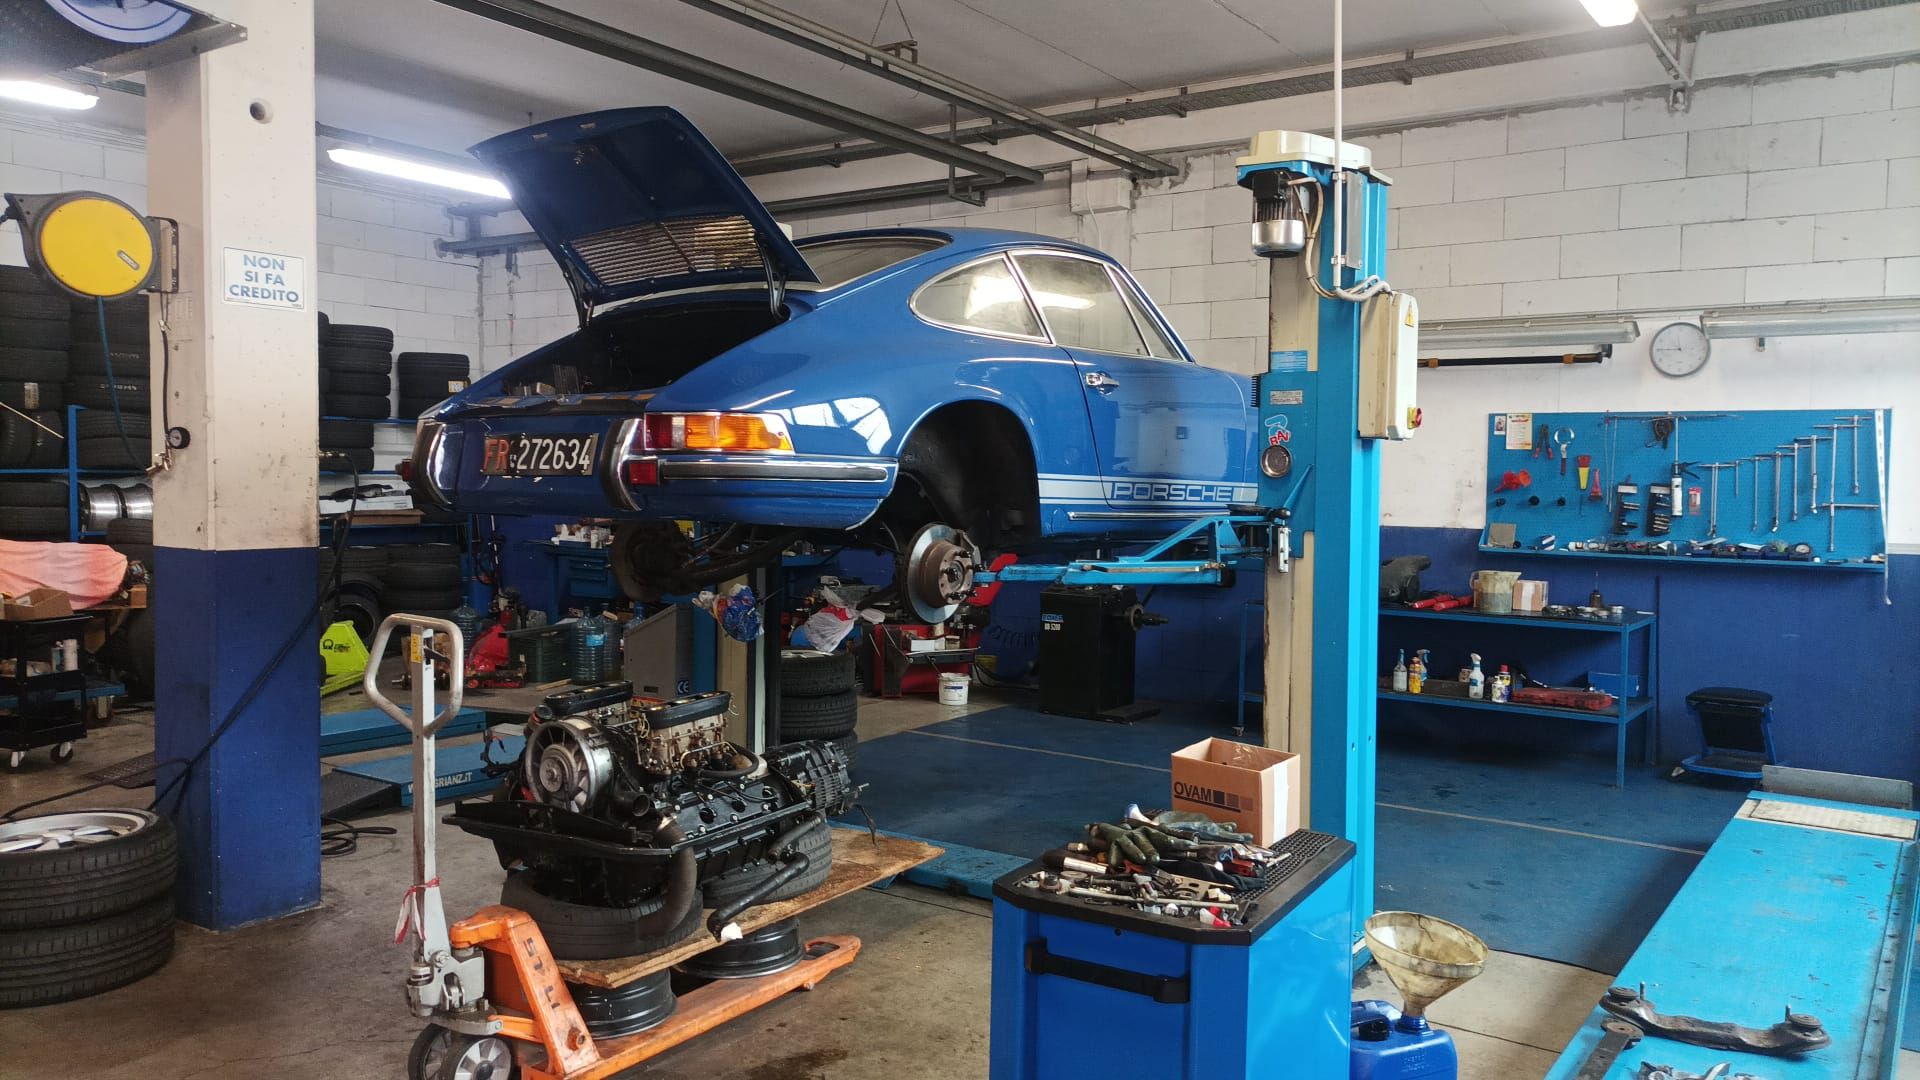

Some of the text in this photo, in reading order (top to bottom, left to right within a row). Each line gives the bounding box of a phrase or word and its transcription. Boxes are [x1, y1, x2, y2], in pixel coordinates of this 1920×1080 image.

[243, 254, 285, 271] NON
[244, 270, 285, 286] SI FA
[229, 284, 299, 302] CREDITO
[483, 438, 590, 470] FR 272634
[1113, 482, 1233, 501] PORSCHE
[1174, 781, 1212, 802] OVAM
